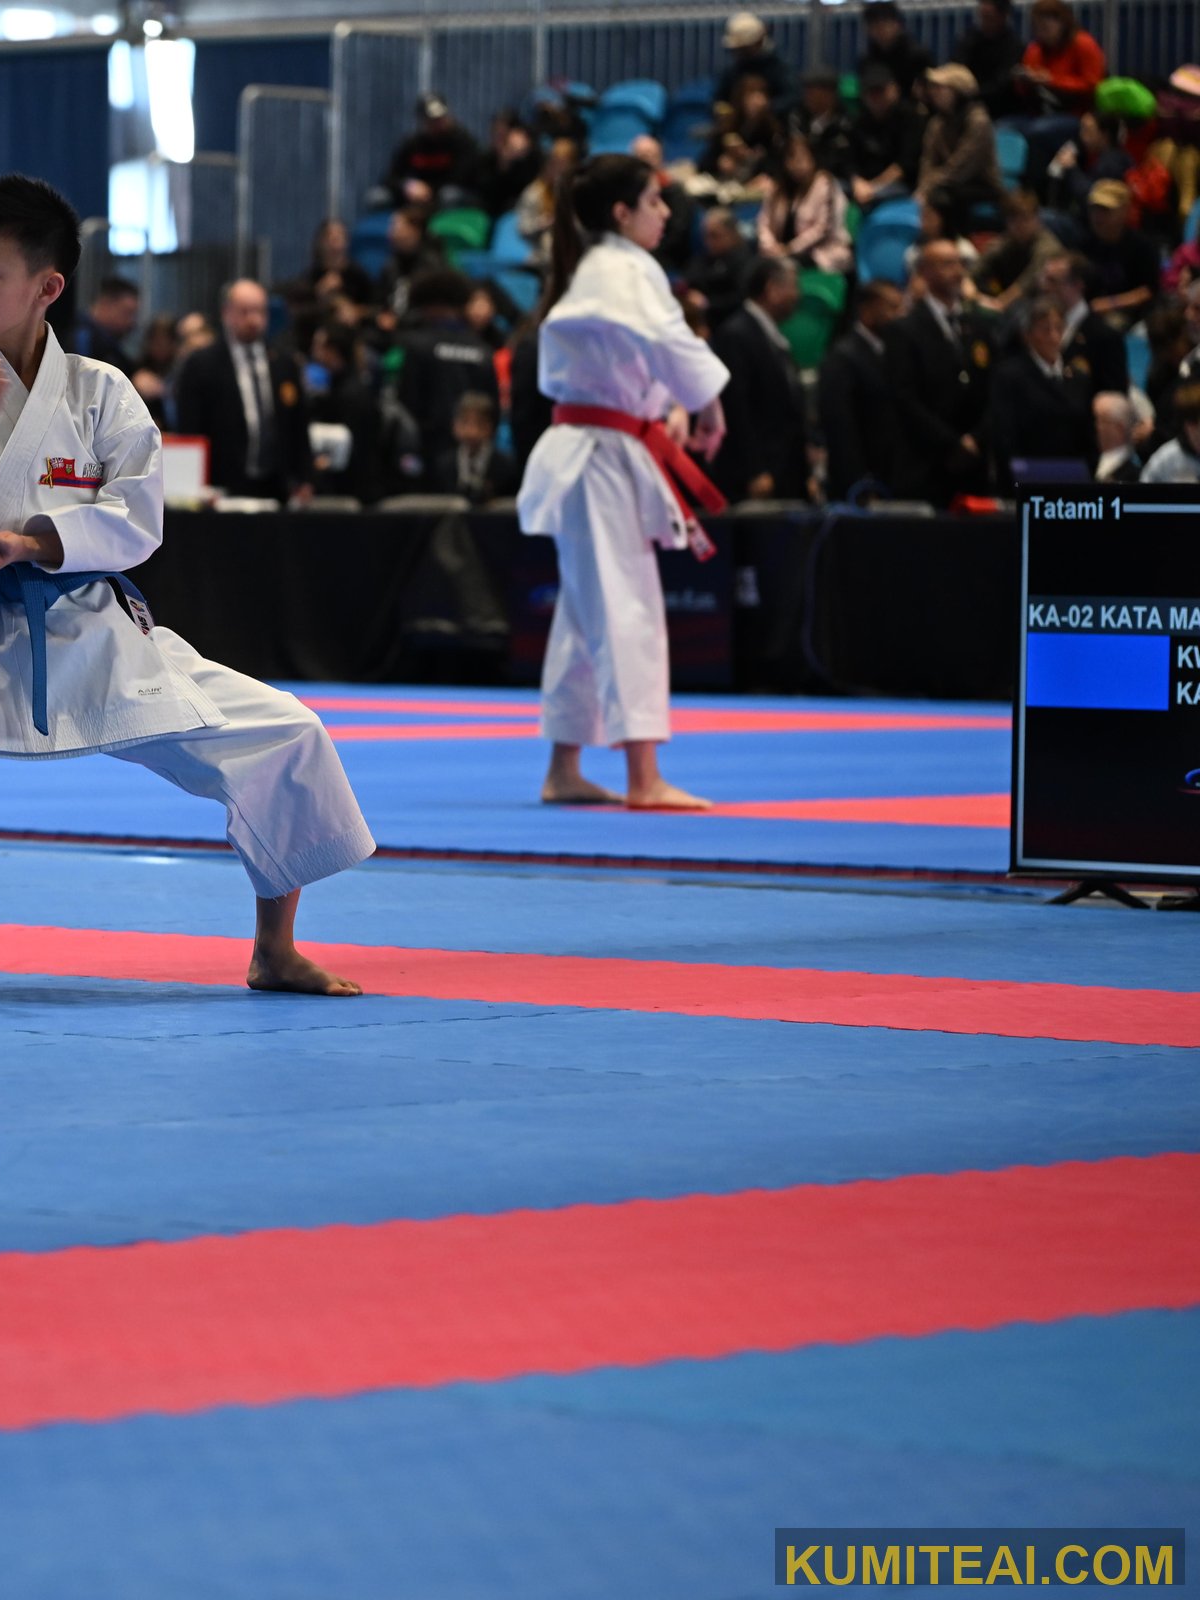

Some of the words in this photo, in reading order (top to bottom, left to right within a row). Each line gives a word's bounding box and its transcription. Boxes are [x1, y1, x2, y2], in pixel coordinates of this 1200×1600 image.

[1030, 496, 1103, 520] Tatami
[1111, 496, 1121, 520] 1
[1029, 603, 1094, 628] KA-02
[1100, 605, 1163, 629] KATA
[1169, 606, 1200, 630] MA
